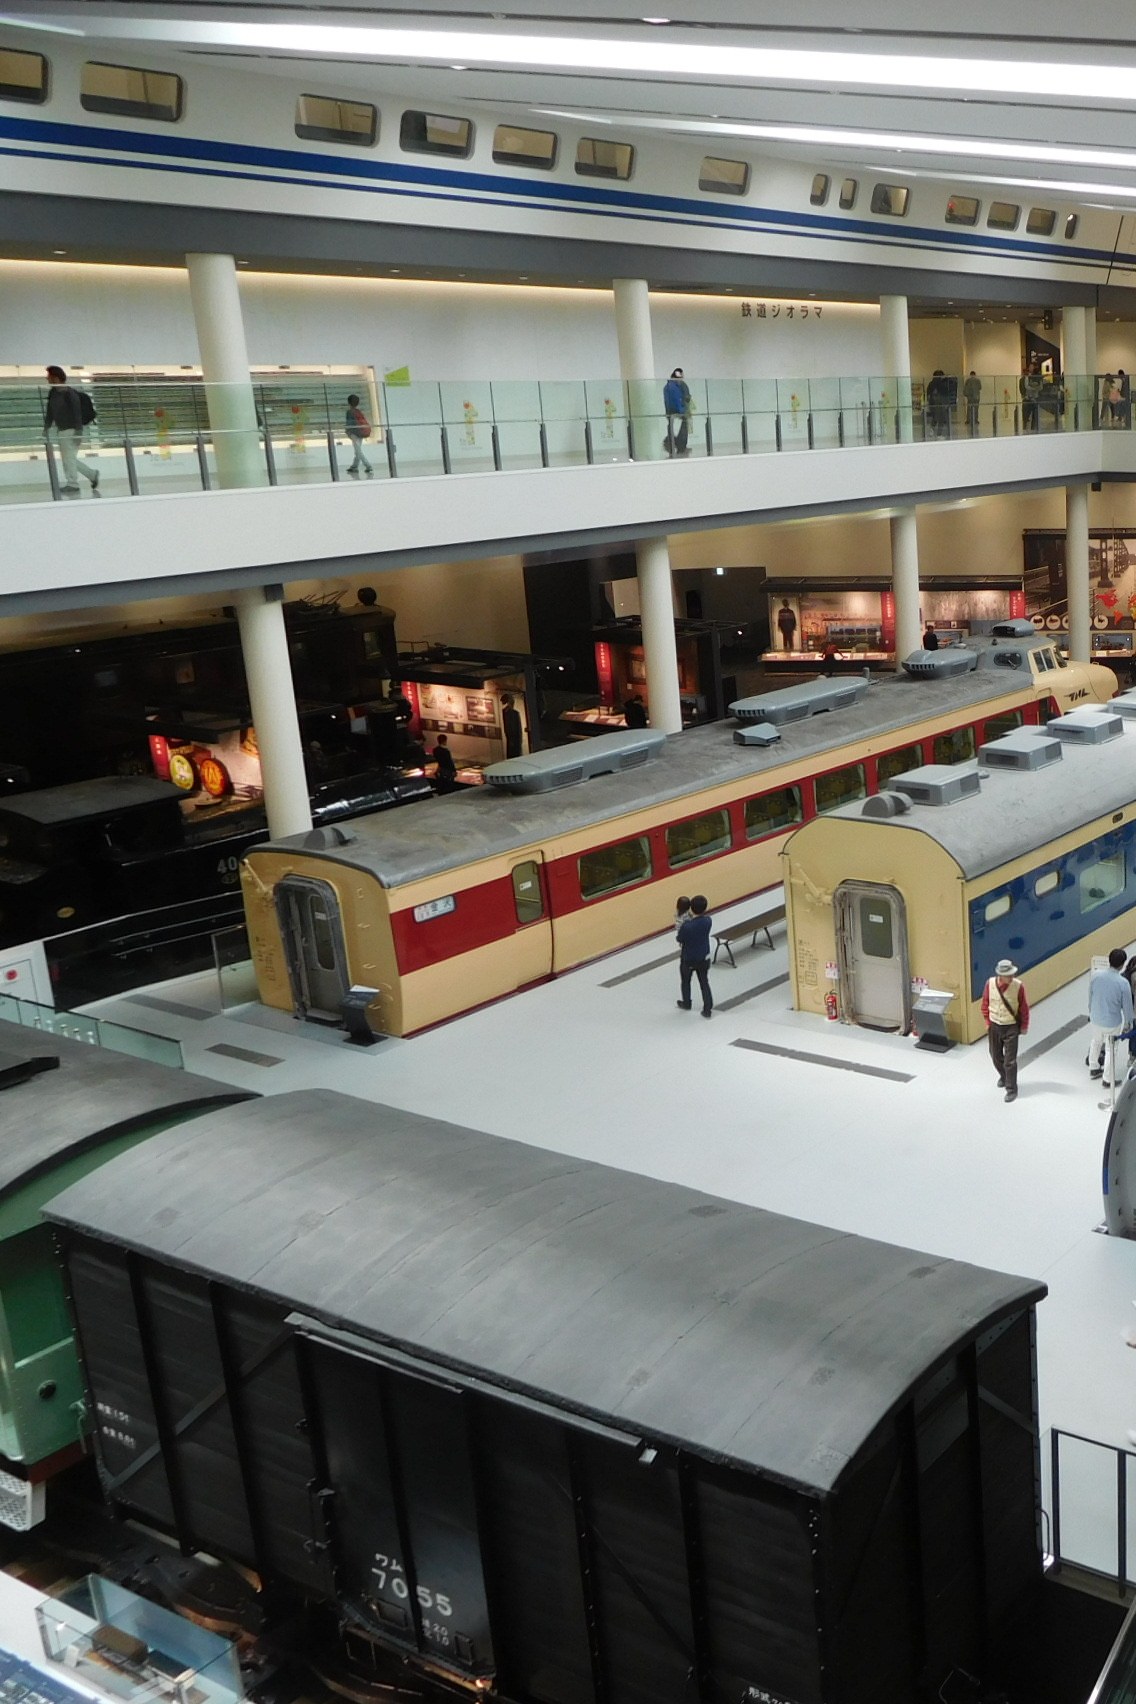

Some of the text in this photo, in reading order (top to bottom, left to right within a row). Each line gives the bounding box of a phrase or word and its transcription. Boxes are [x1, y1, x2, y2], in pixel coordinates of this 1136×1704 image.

[741, 301, 823, 319] 鉄道ジオラマ
[375, 1553, 403, 1572] ワム
[371, 1567, 452, 1617] 7055
